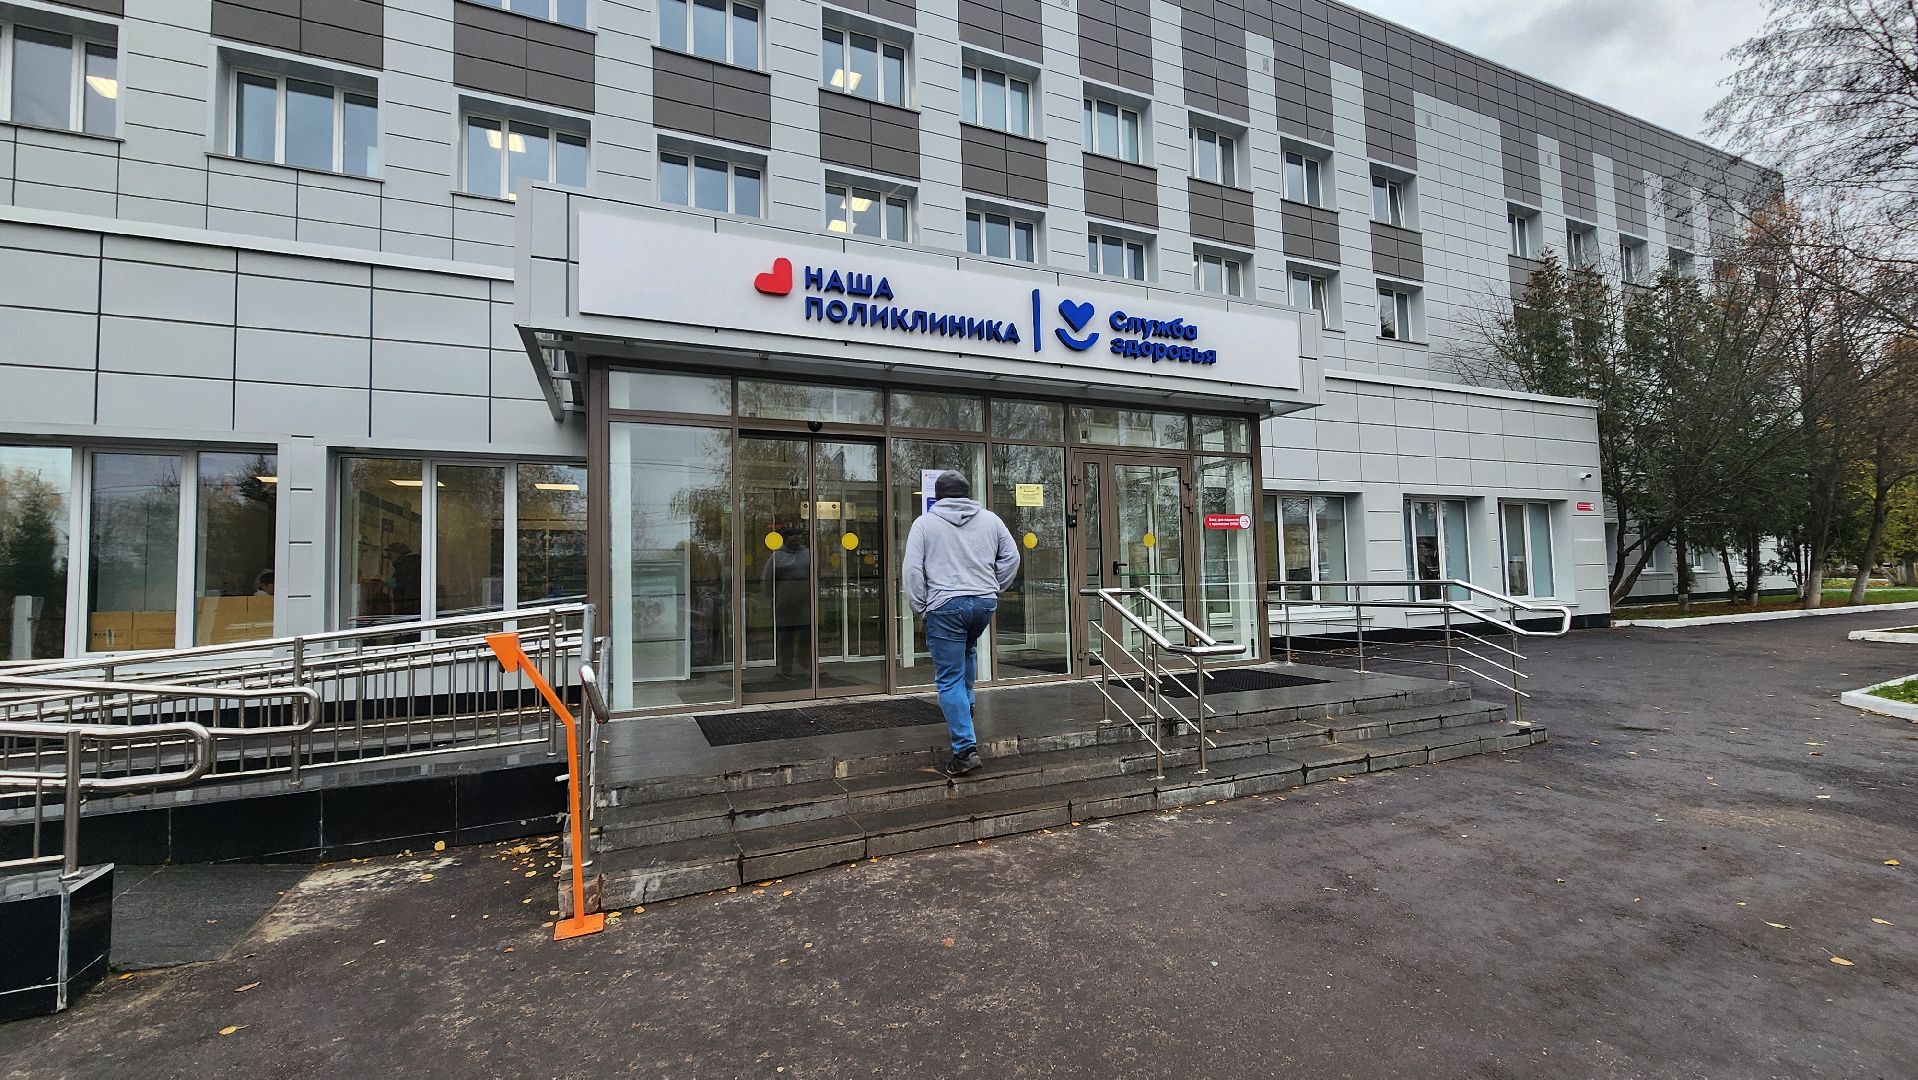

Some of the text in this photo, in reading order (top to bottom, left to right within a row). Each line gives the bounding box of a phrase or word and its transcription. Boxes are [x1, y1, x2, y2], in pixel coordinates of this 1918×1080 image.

[805, 265, 894, 300] НАША
[805, 296, 1020, 344] ПОЛИКЛИНИКА
[1109, 310, 1197, 340] Служба
[1110, 337, 1216, 364] здоровья
